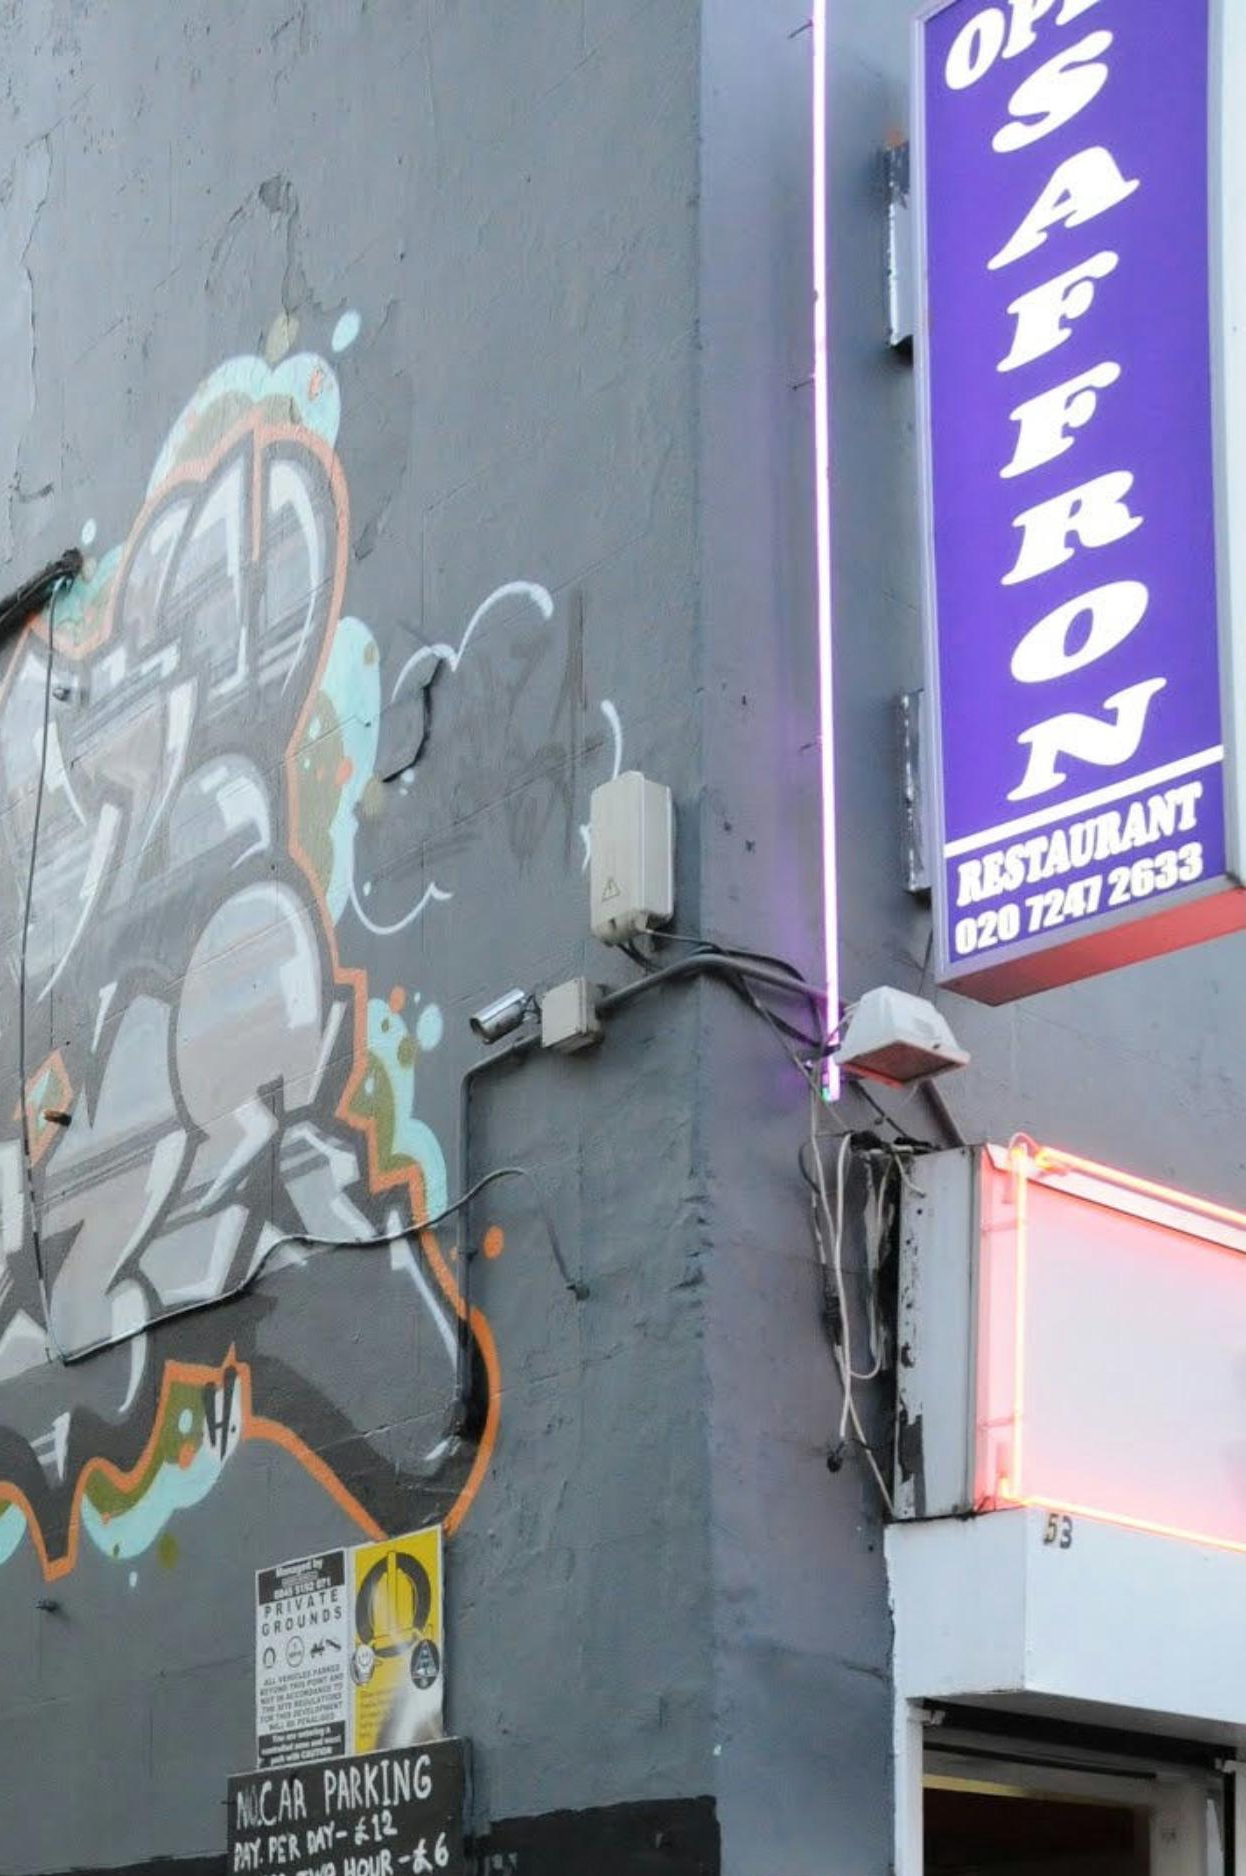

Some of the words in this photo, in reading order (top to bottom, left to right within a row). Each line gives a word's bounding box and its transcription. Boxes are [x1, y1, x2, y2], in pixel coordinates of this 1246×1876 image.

[987, 30, 1167, 801] SAFFRON
[957, 781, 1203, 906] RESTAURANT
[955, 903, 1020, 955] 020
[1025, 873, 1102, 932] 7247
[1108, 841, 1203, 907] 2633
[1042, 1512, 1073, 1549] 53
[261, 1606, 342, 1637] GROUNDS
[264, 1588, 339, 1618] PRIVATE
[324, 1754, 432, 1816] PARKING
[268, 1833, 301, 1864] PER
[354, 1809, 398, 1846] £12
